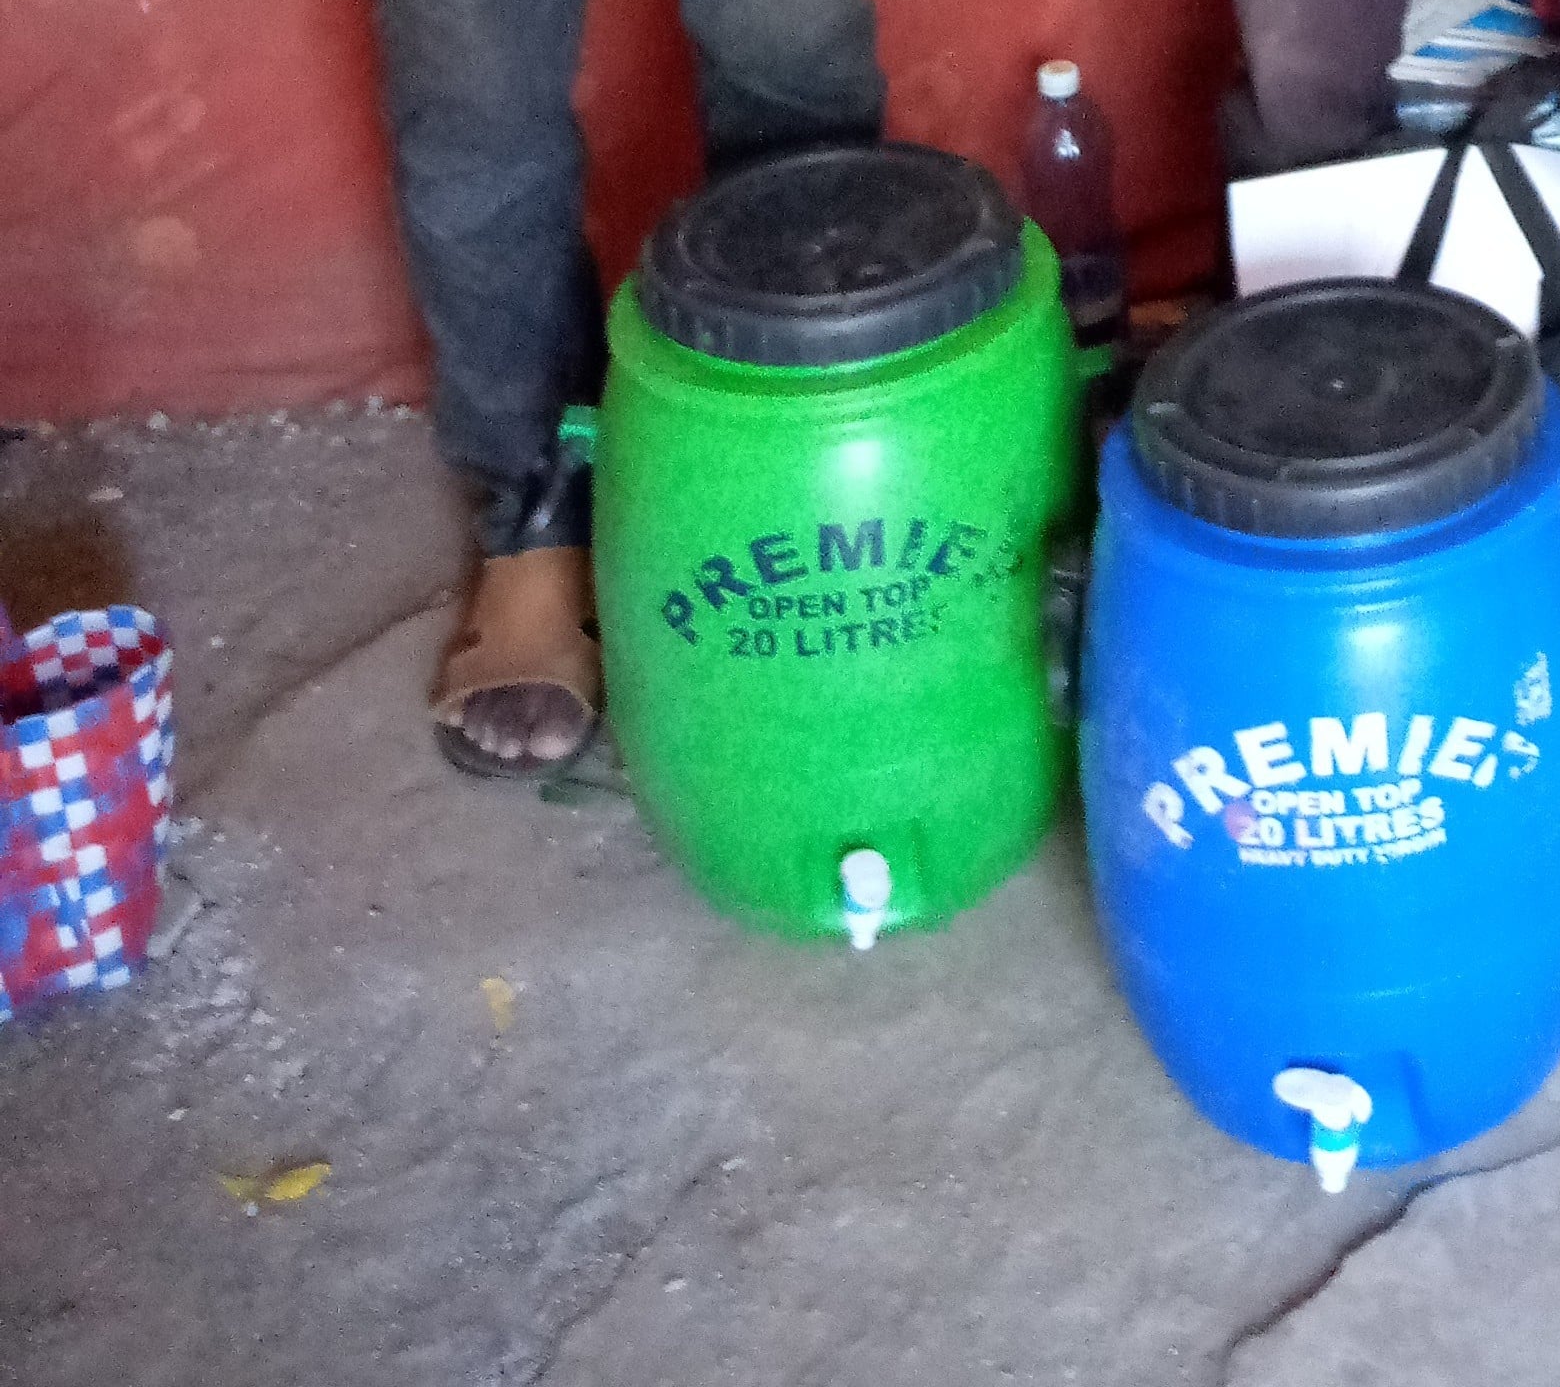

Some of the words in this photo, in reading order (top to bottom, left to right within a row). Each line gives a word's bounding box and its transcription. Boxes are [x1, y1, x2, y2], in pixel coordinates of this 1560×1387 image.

[748, 589, 848, 621] OPEN
[861, 574, 933, 613] TOP
[728, 626, 778, 658] 20
[1251, 788, 1346, 816] OPEN
[1351, 777, 1422, 812] TOP
[1294, 795, 1446, 848] LITRES
